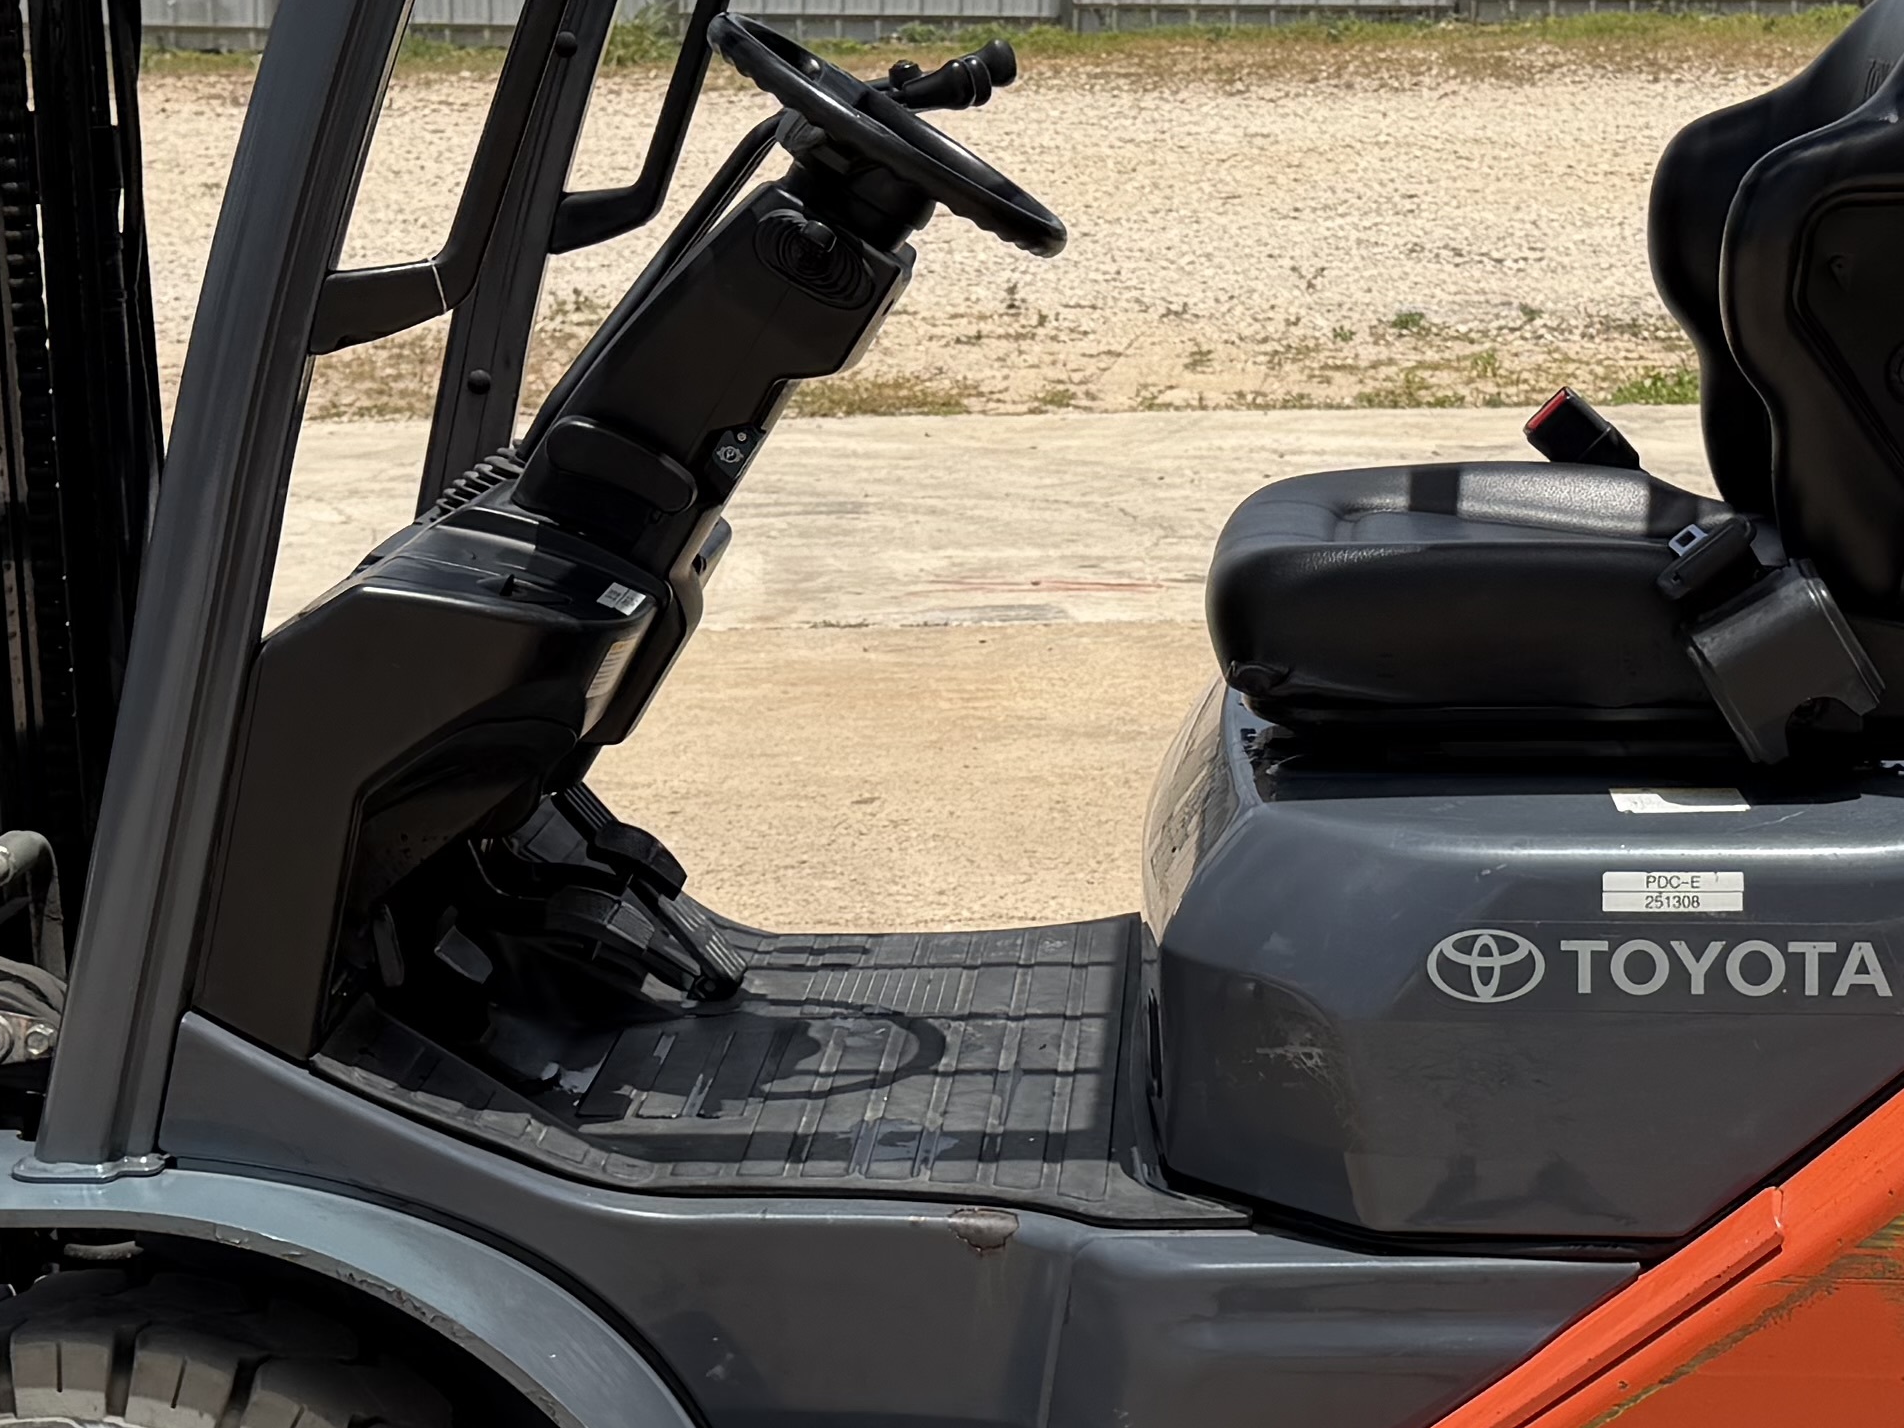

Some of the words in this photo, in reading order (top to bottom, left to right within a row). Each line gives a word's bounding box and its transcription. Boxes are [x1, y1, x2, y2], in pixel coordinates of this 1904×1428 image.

[1645, 875, 1701, 890] PDC-E
[1644, 894, 1701, 909] 251308
[1560, 939, 1893, 997] TOYOTA
